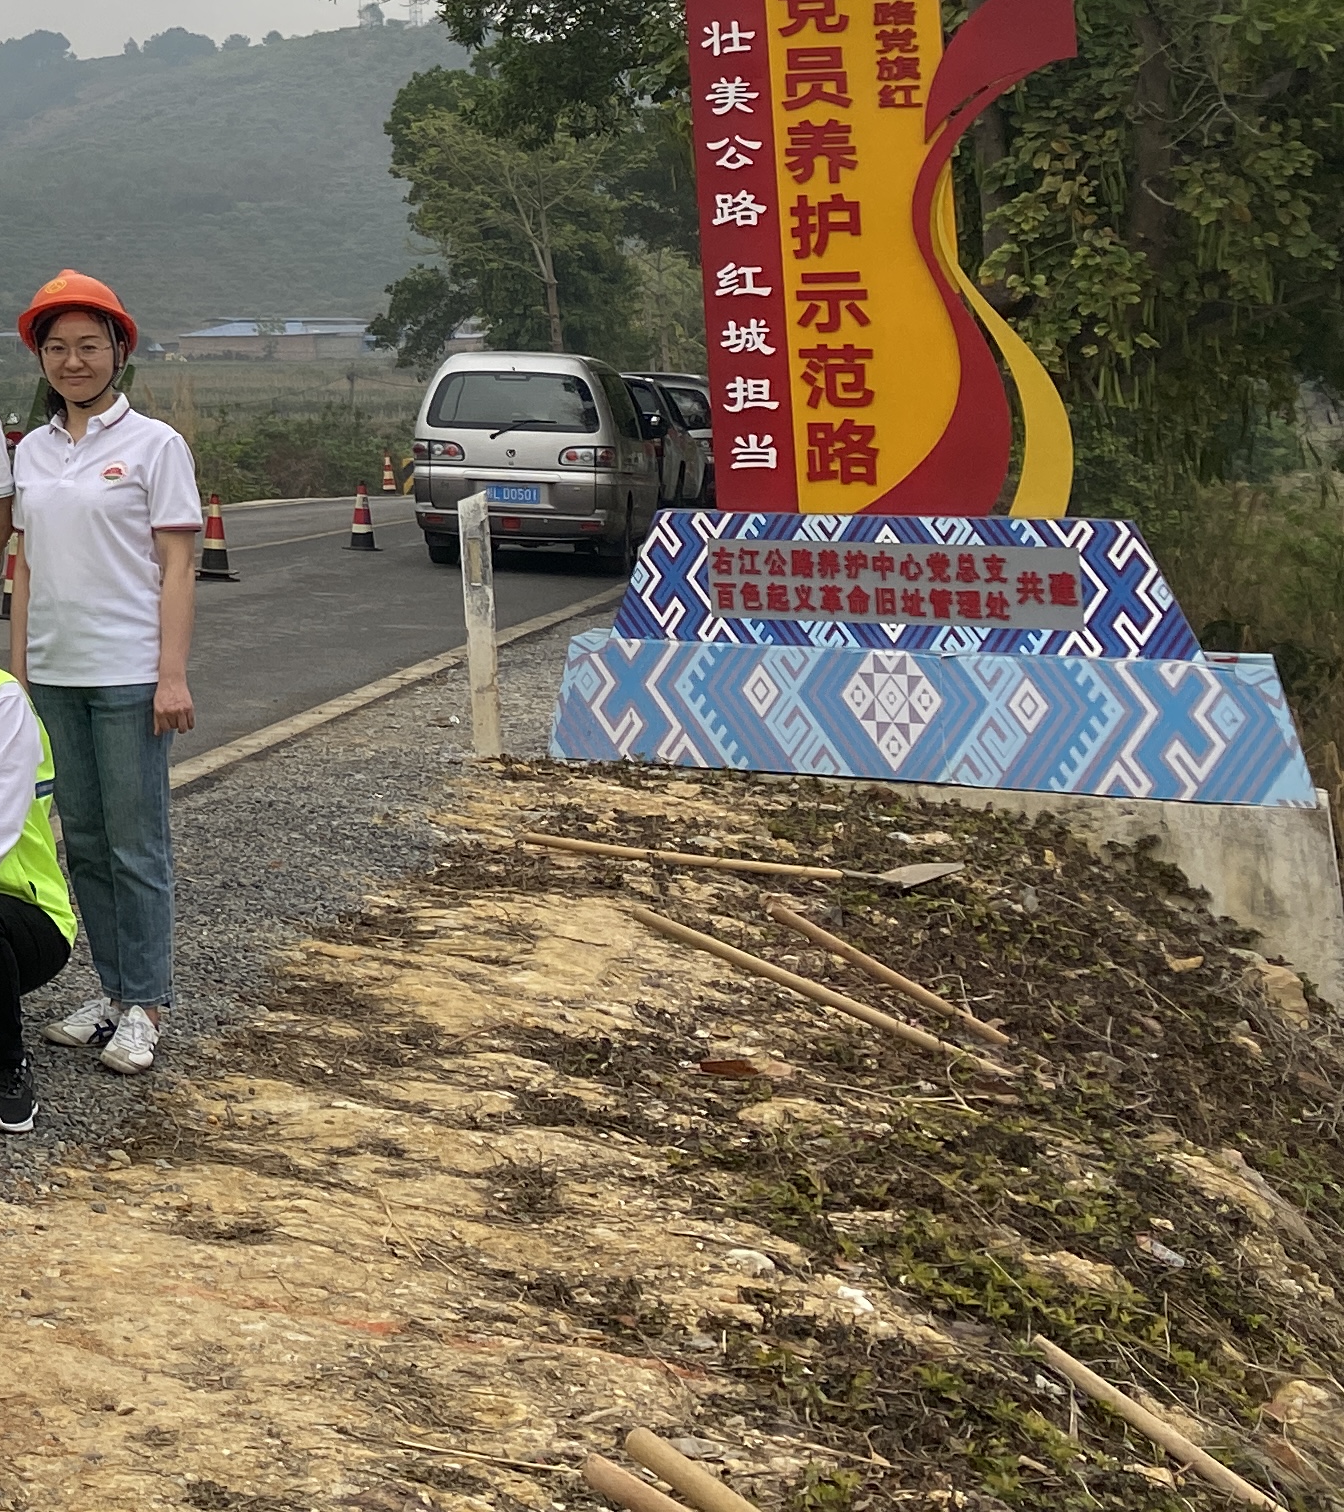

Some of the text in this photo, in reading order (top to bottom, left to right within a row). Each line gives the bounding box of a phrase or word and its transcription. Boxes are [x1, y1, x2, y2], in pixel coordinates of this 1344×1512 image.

[701, 20, 779, 470] 壮美公路 红城担当
[712, 547, 1009, 584] 右江公路养护中心党总支
[713, 582, 1011, 621] 百色起义革命旧址管理处
[1016, 571, 1078, 607] 共建
